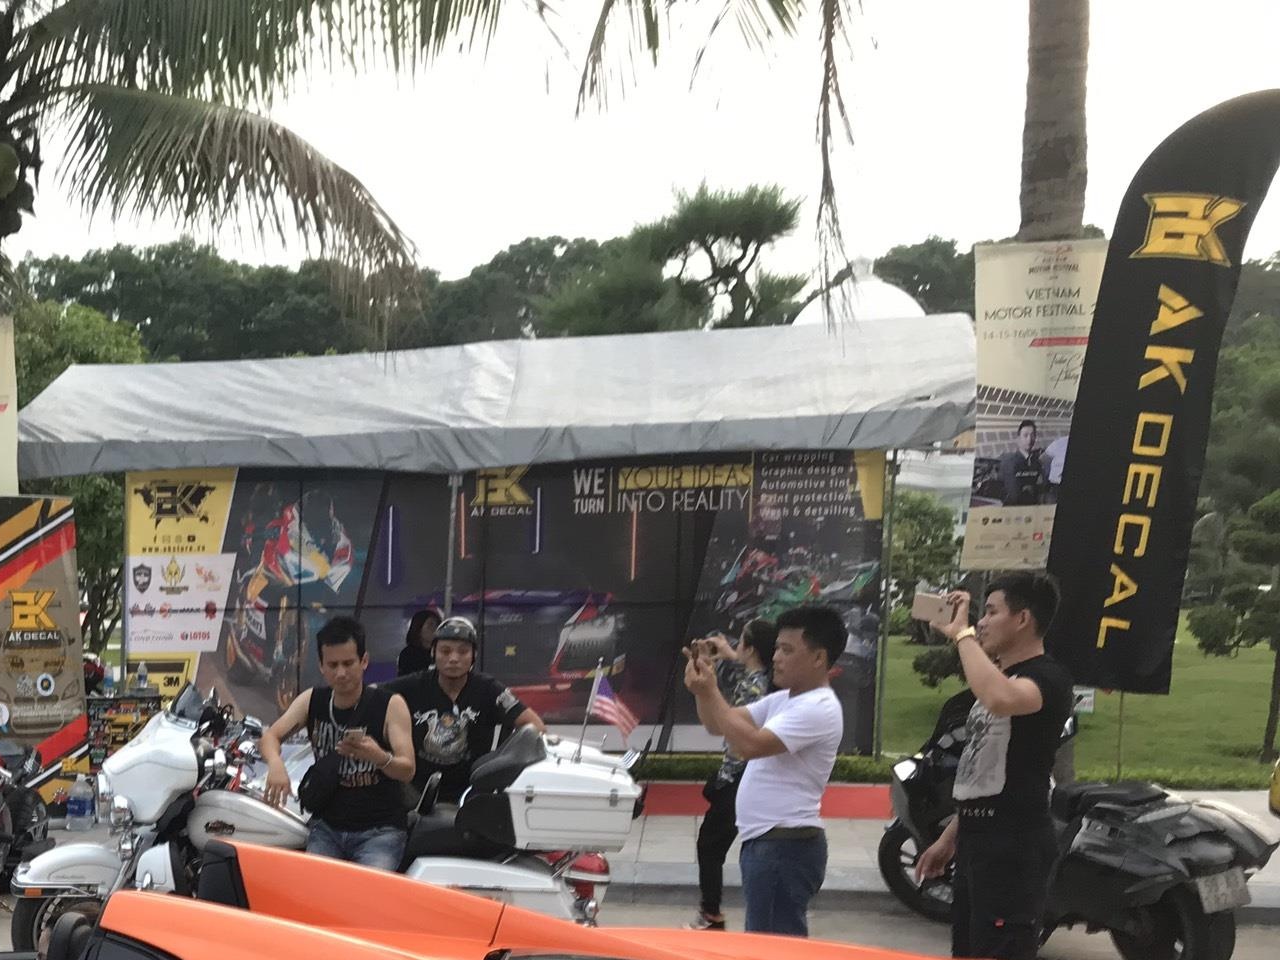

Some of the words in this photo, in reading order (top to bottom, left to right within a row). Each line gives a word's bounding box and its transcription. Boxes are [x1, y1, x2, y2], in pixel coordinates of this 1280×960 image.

[1026, 287, 1081, 300] VIETNAM
[984, 306, 1033, 321] MOTOR
[1036, 303, 1086, 317] FESTIVAL
[1138, 283, 1205, 396] AK
[621, 465, 684, 490] YOUR
[692, 464, 751, 487] IDEAS
[761, 466, 804, 477] Graphic
[807, 465, 844, 476] design
[573, 468, 606, 496] WE
[761, 480, 826, 490] Automotive
[618, 492, 666, 512] INTO
[672, 488, 748, 511] REALITY
[793, 492, 852, 504] protection
[573, 498, 605, 514] TURN
[805, 505, 856, 517] detailing
[1096, 411, 1174, 649] DECAL
[8, 631, 23, 642] AK
[24, 631, 60, 641] DECAL
[163, 676, 179, 687] 3M
